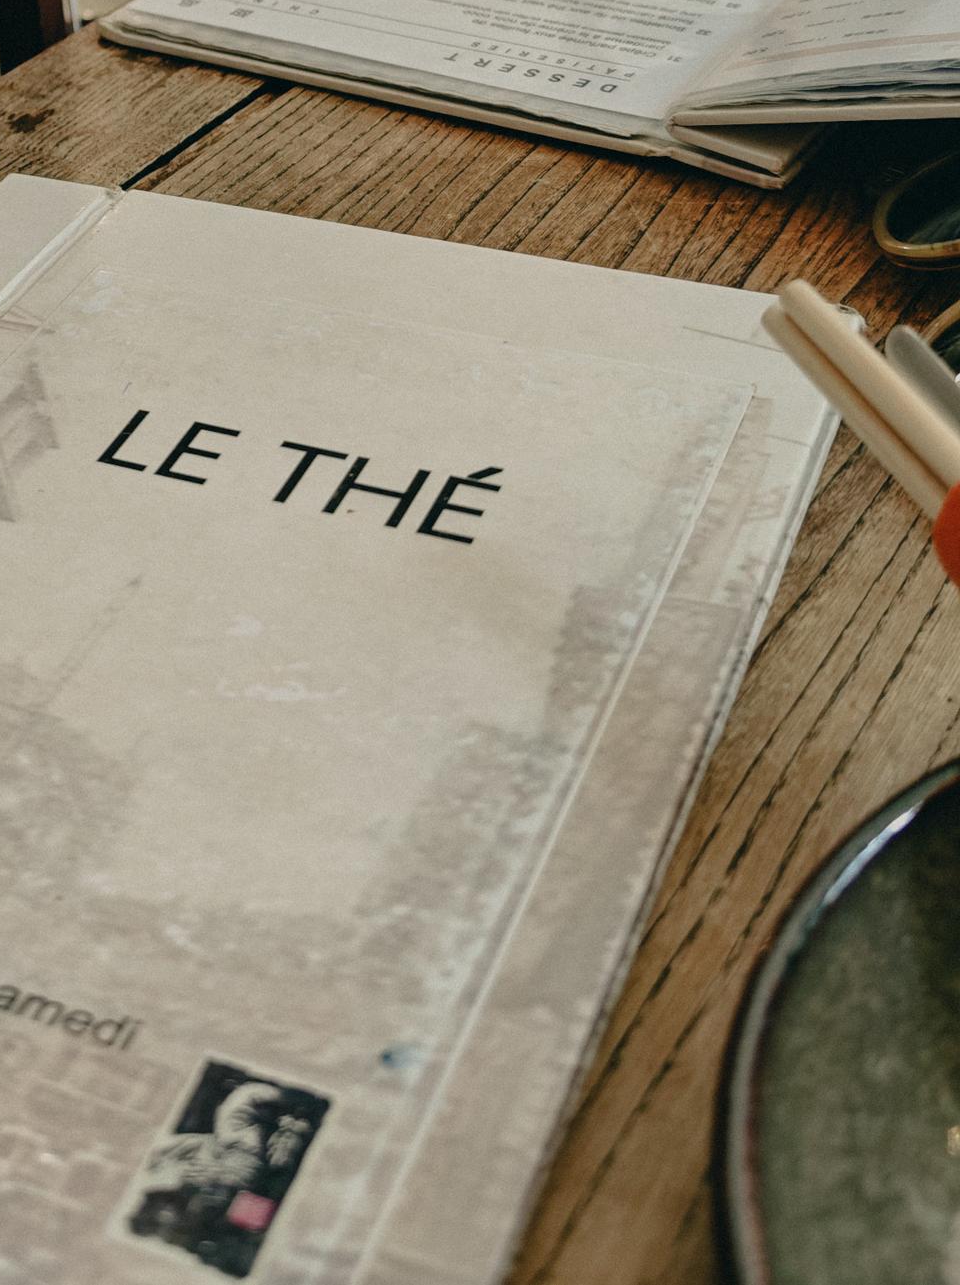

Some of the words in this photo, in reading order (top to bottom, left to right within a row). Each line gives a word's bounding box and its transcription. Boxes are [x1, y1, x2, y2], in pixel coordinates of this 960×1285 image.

[442, 52, 618, 93] DESSERT
[97, 410, 240, 484] LE
[273, 466, 503, 543] THÉ
